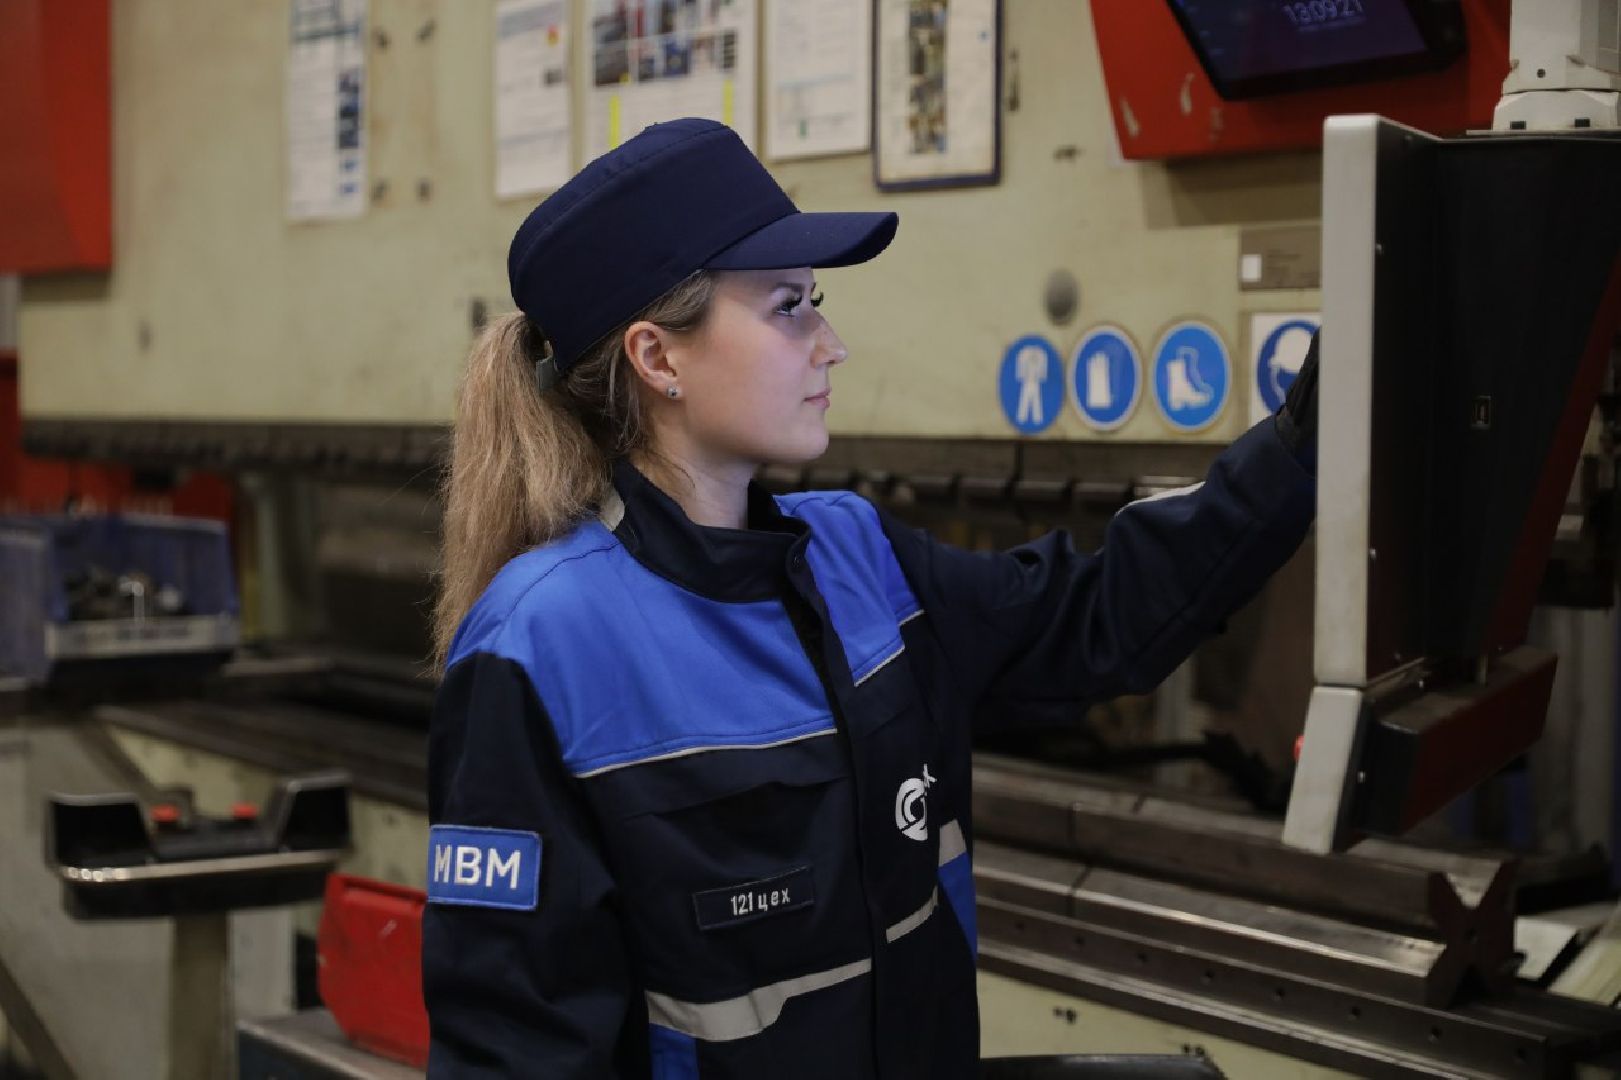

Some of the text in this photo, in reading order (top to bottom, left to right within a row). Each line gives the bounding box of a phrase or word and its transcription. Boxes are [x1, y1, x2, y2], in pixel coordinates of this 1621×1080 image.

[434, 844, 520, 889] МВМ
[730, 888, 790, 915] 121 цех
